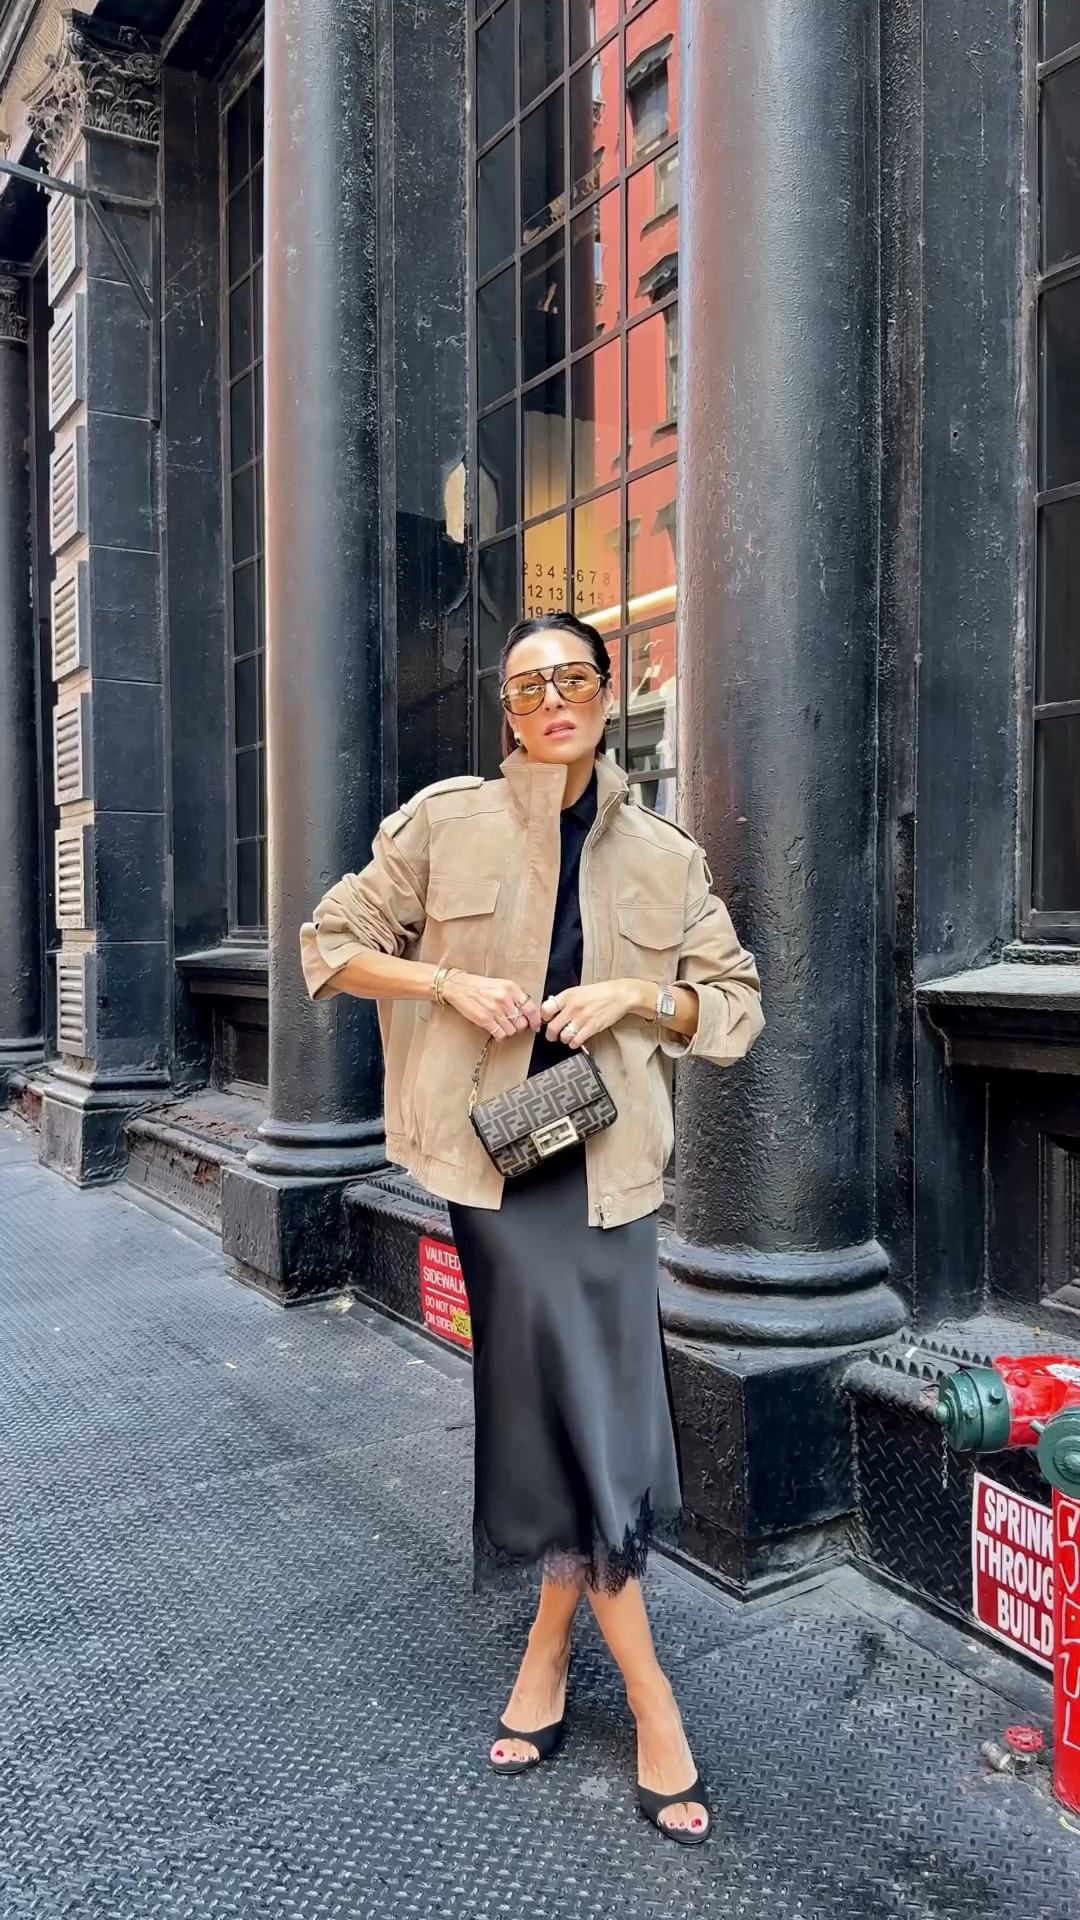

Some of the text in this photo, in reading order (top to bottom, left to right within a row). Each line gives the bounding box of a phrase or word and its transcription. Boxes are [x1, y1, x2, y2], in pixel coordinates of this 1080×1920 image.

[535, 564, 543, 577] 3
[547, 565, 555, 579] 4
[576, 569, 584, 583] 6
[589, 570, 597, 584] 7
[603, 572, 610, 586] 8
[527, 584, 543, 598] 12
[548, 587, 564, 601] 13
[589, 591, 604, 606] 15
[424, 1245, 462, 1271] VAULTED
[423, 1265, 467, 1297] SIDEWALK
[424, 1294, 435, 1309] DO
[435, 1298, 449, 1314] NOT
[425, 1310, 436, 1325] ON
[983, 1488, 1054, 1562] SPRINK
[976, 1530, 1054, 1611] THROUG
[997, 1587, 1055, 1657] BUILD
